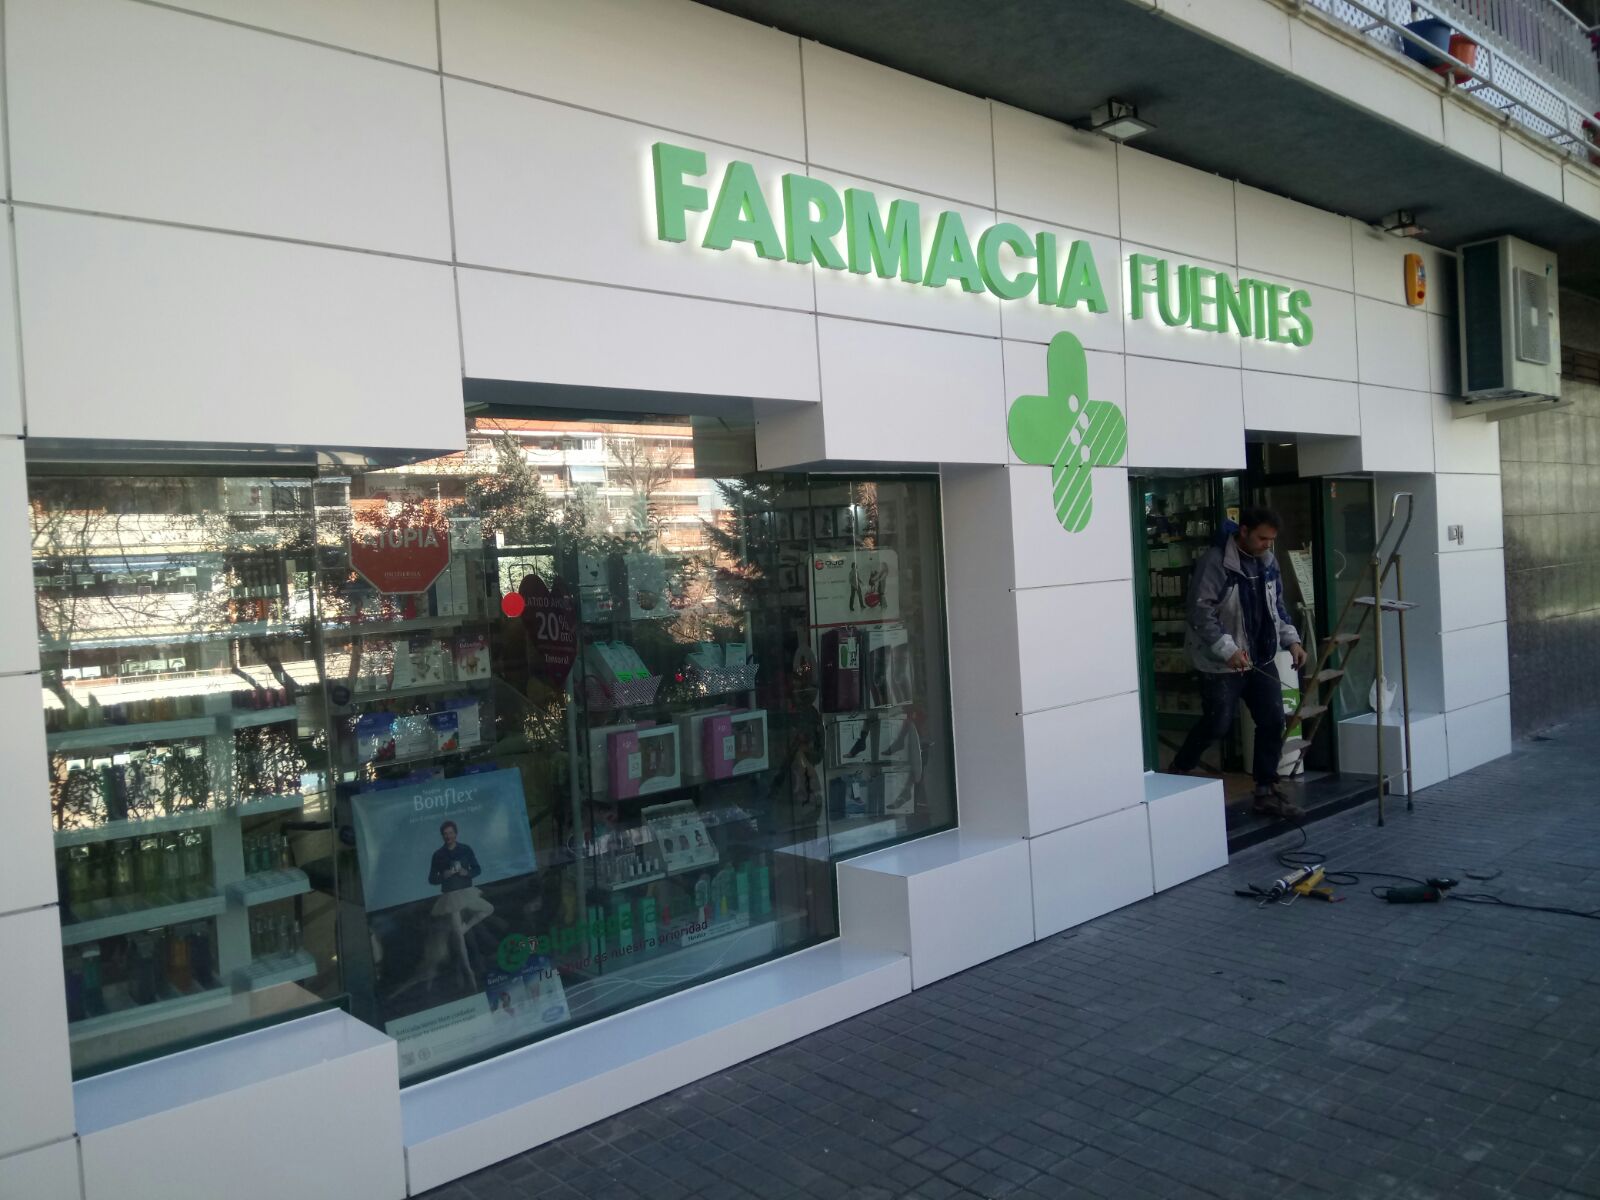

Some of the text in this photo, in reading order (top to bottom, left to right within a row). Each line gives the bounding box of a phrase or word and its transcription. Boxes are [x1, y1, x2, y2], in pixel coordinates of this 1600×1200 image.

[652, 142, 1312, 347] FARMACIA FUENTES
[413, 787, 473, 811] Bonflex
[536, 967, 553, 981] Tu
[594, 953, 607, 964] es
